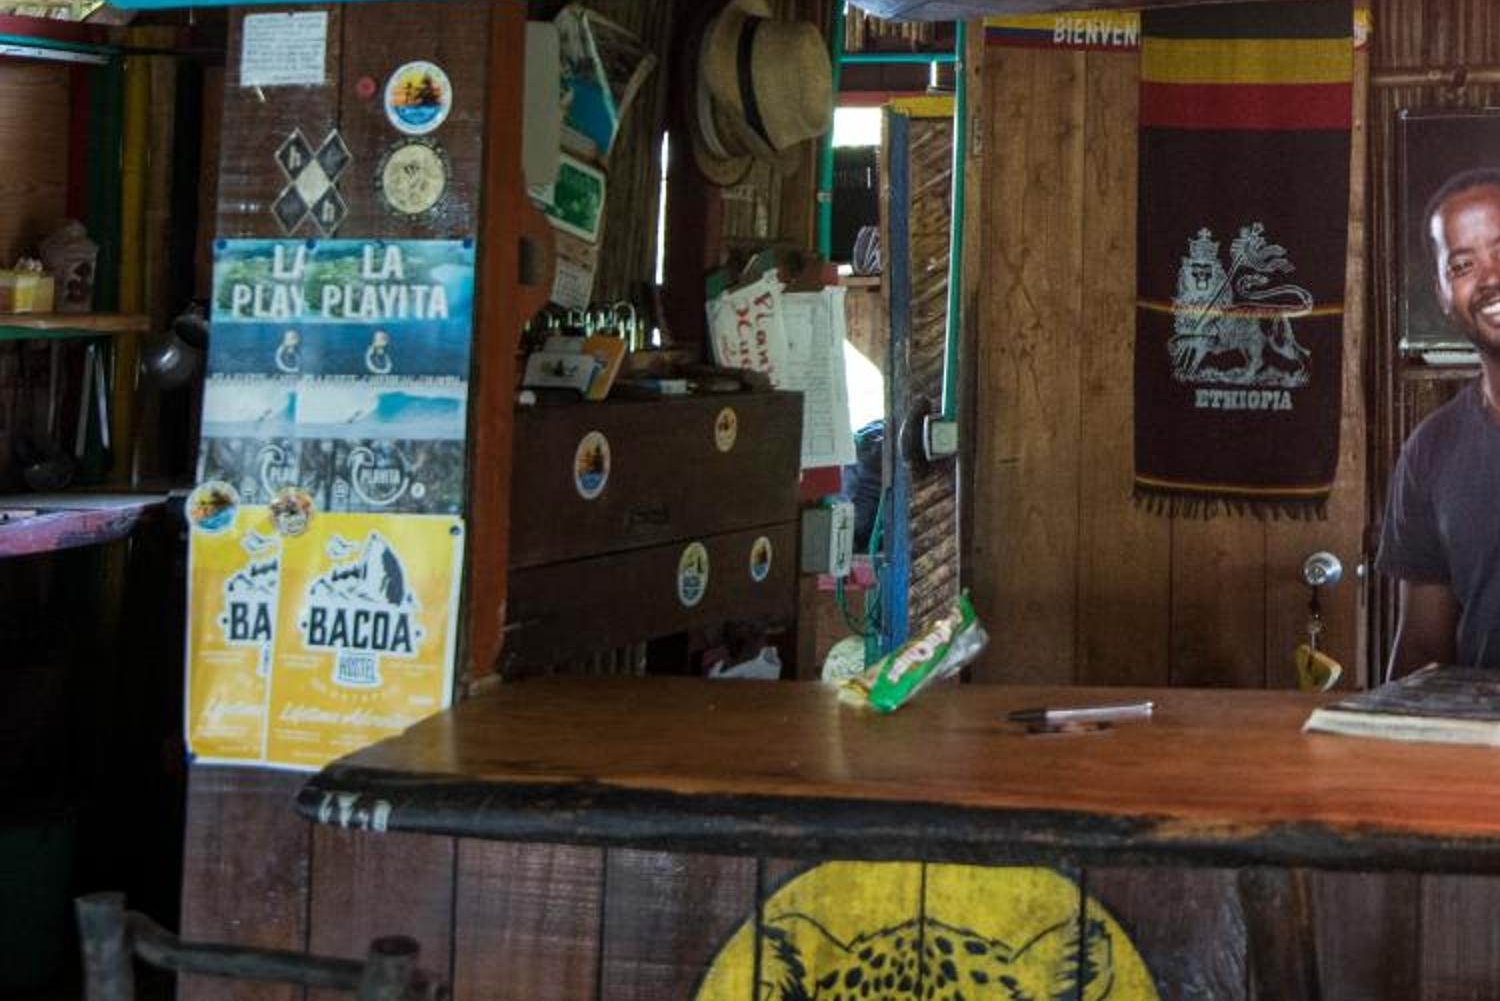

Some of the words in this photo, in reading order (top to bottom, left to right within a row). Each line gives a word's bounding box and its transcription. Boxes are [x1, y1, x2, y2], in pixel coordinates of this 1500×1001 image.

[362, 245, 404, 279] LA
[320, 283, 449, 319] PLAYITA
[1195, 389, 1293, 411] ETHIOPIA
[308, 606, 413, 653] BACOA
